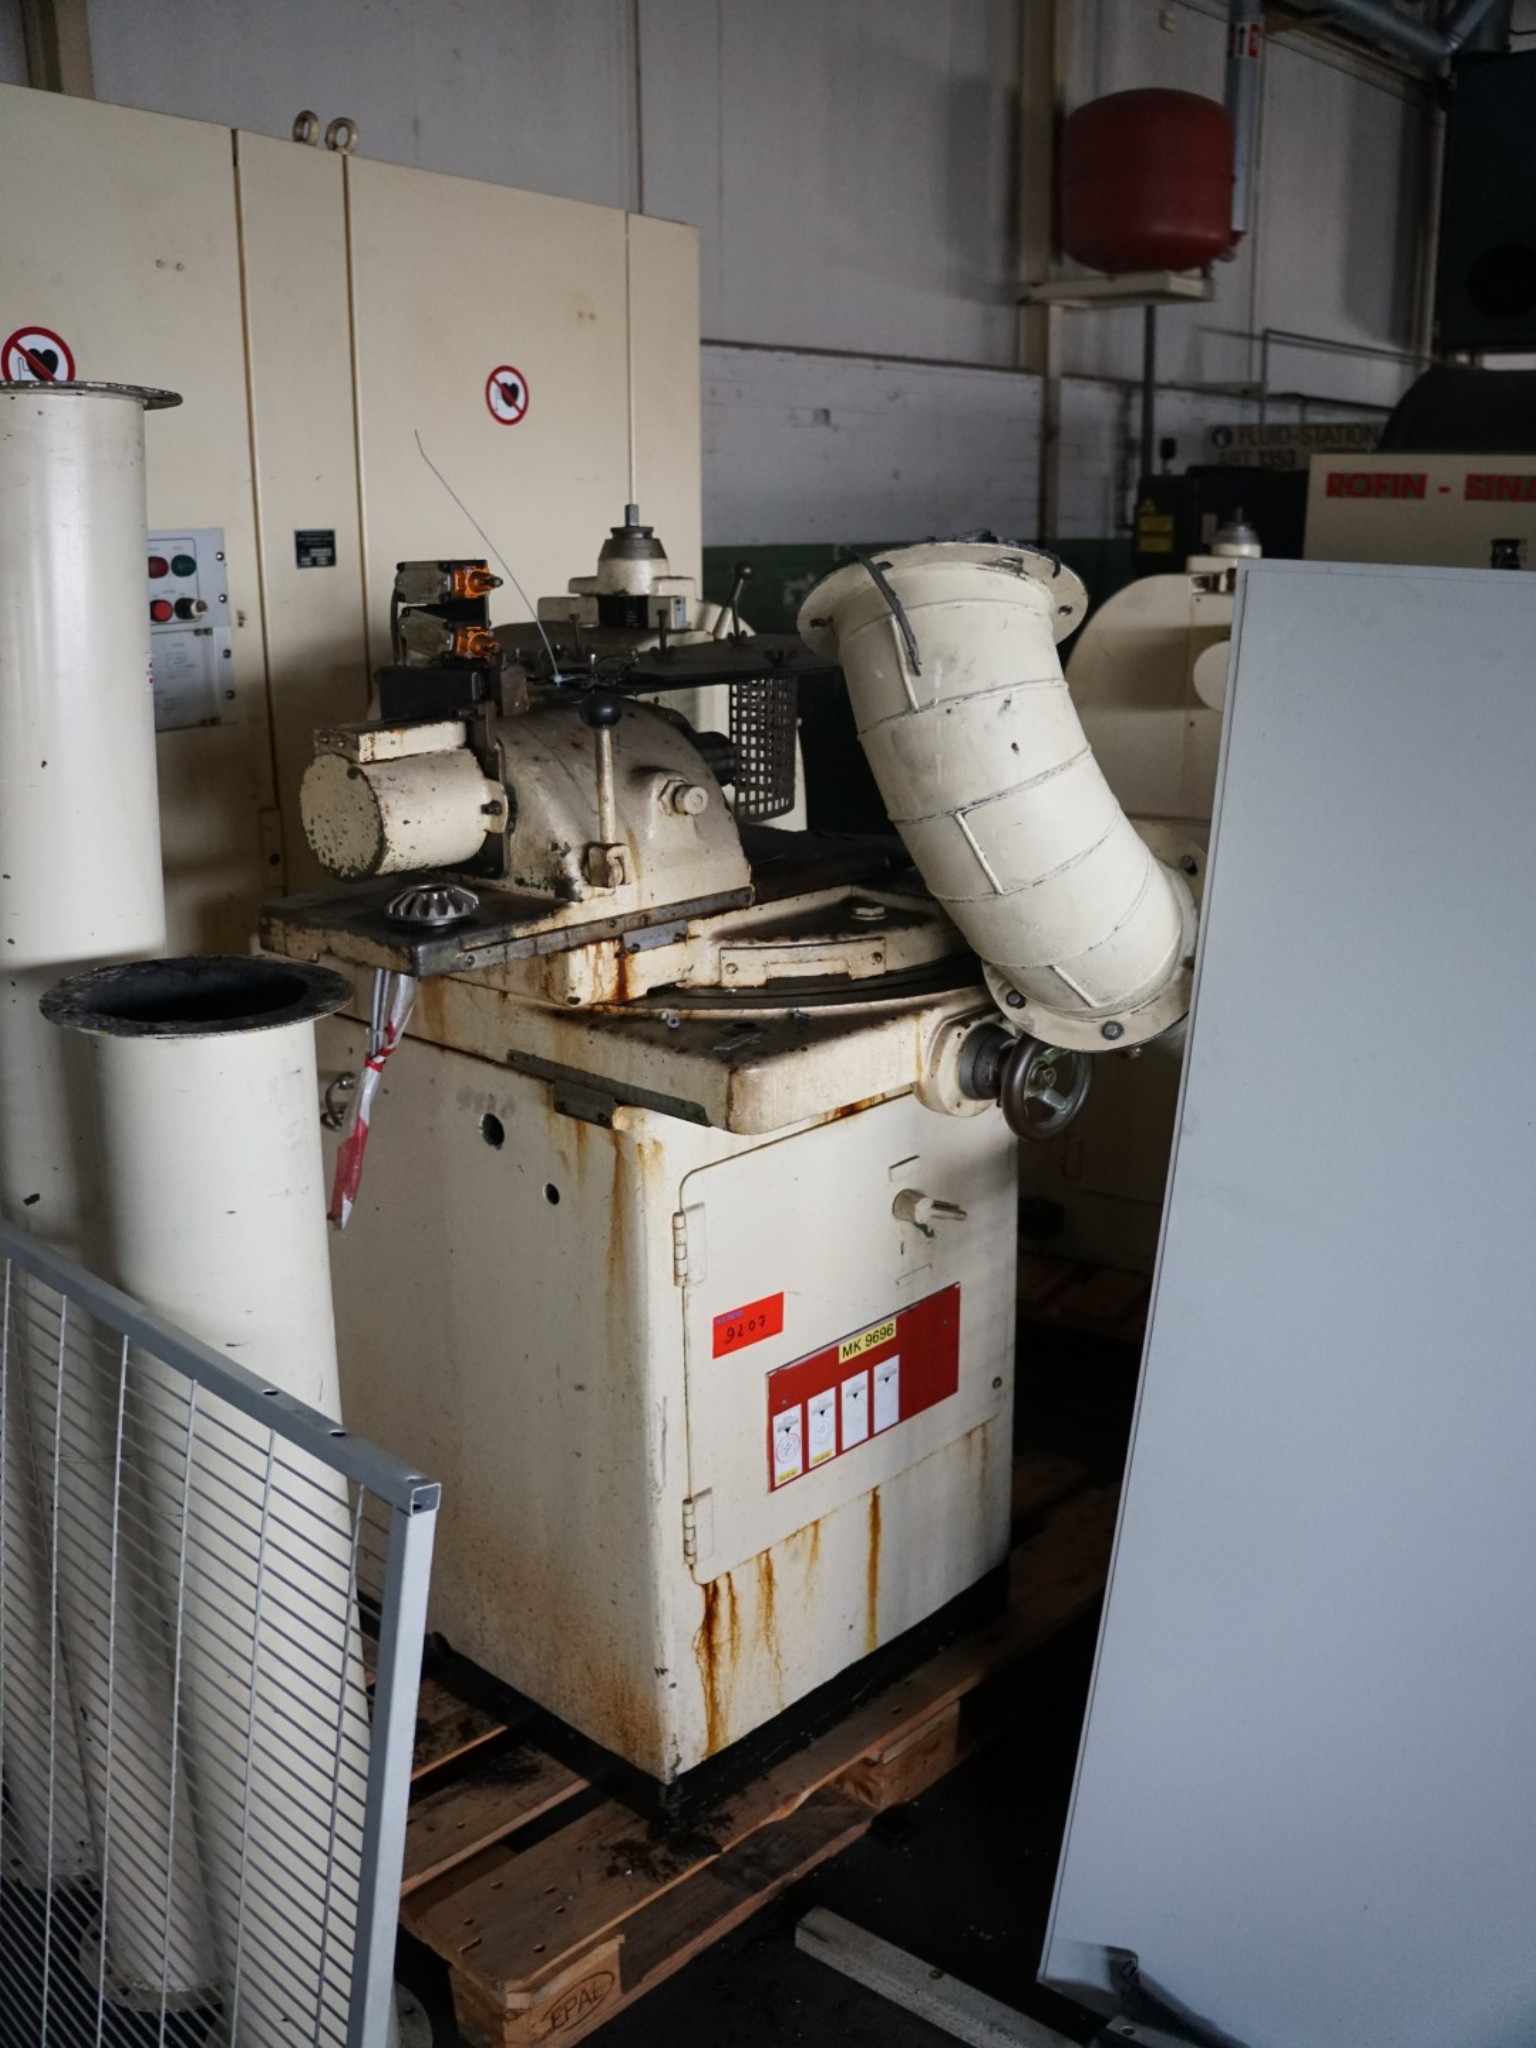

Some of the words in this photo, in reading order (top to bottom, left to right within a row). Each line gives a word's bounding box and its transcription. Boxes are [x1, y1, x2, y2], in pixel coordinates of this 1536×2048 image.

[1238, 423, 1379, 447] FLUID-STATION
[1325, 472, 1427, 499] ROFIN
[724, 1313, 766, 1344] 9207
[842, 1338, 862, 1359] MK
[865, 1322, 894, 1347] 9696
[550, 1982, 606, 2030] EPAL
